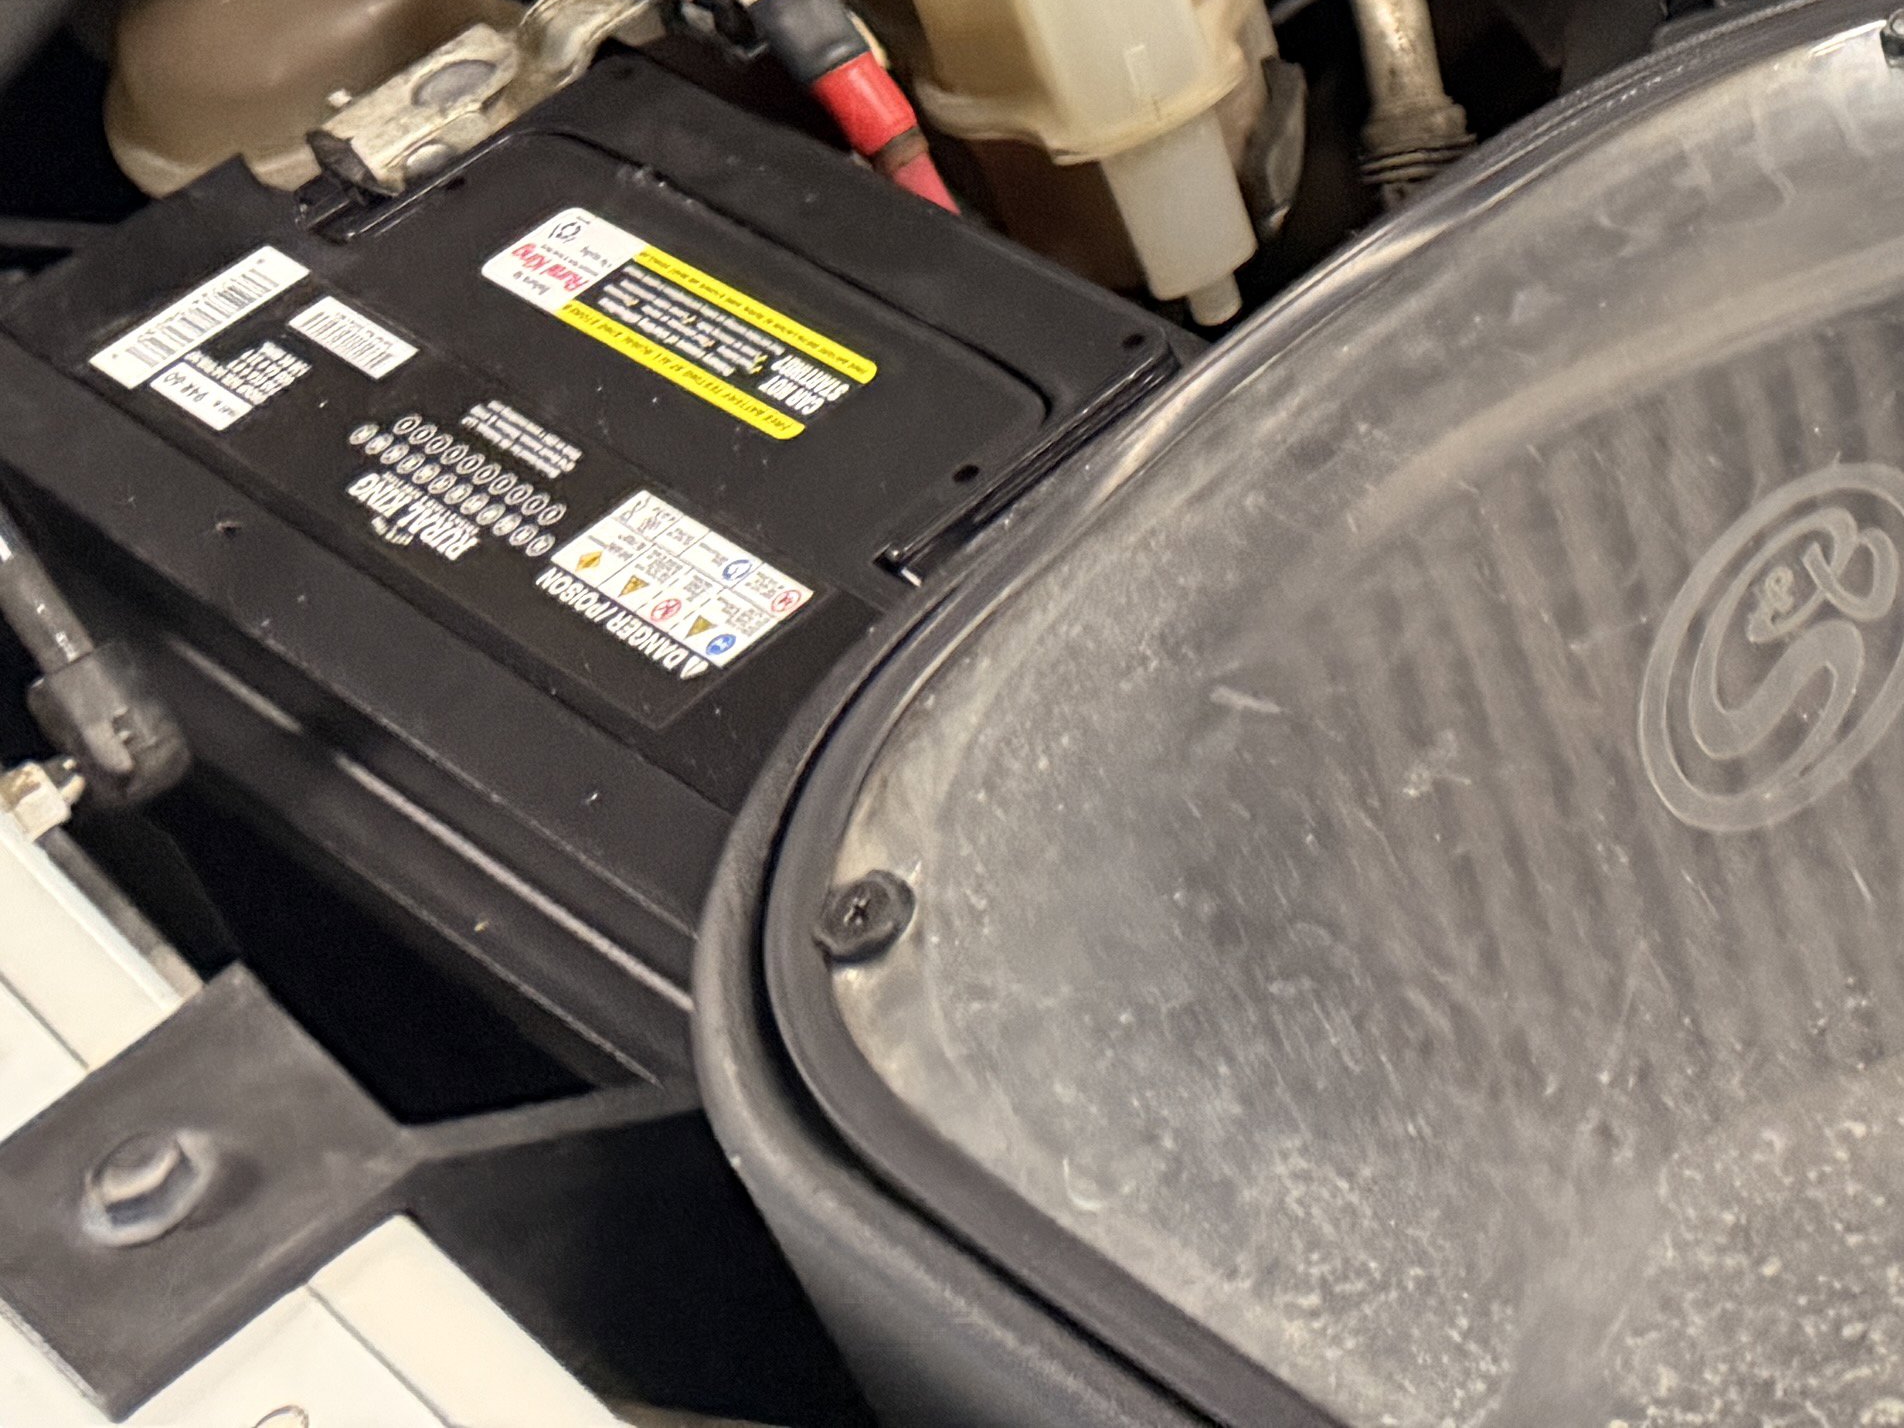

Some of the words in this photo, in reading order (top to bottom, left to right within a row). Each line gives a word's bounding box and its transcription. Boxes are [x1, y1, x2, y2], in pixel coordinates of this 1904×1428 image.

[511, 242, 552, 271] King
[346, 472, 413, 519] KING
[396, 495, 480, 561] RURAL
[605, 609, 690, 671] DANGER
